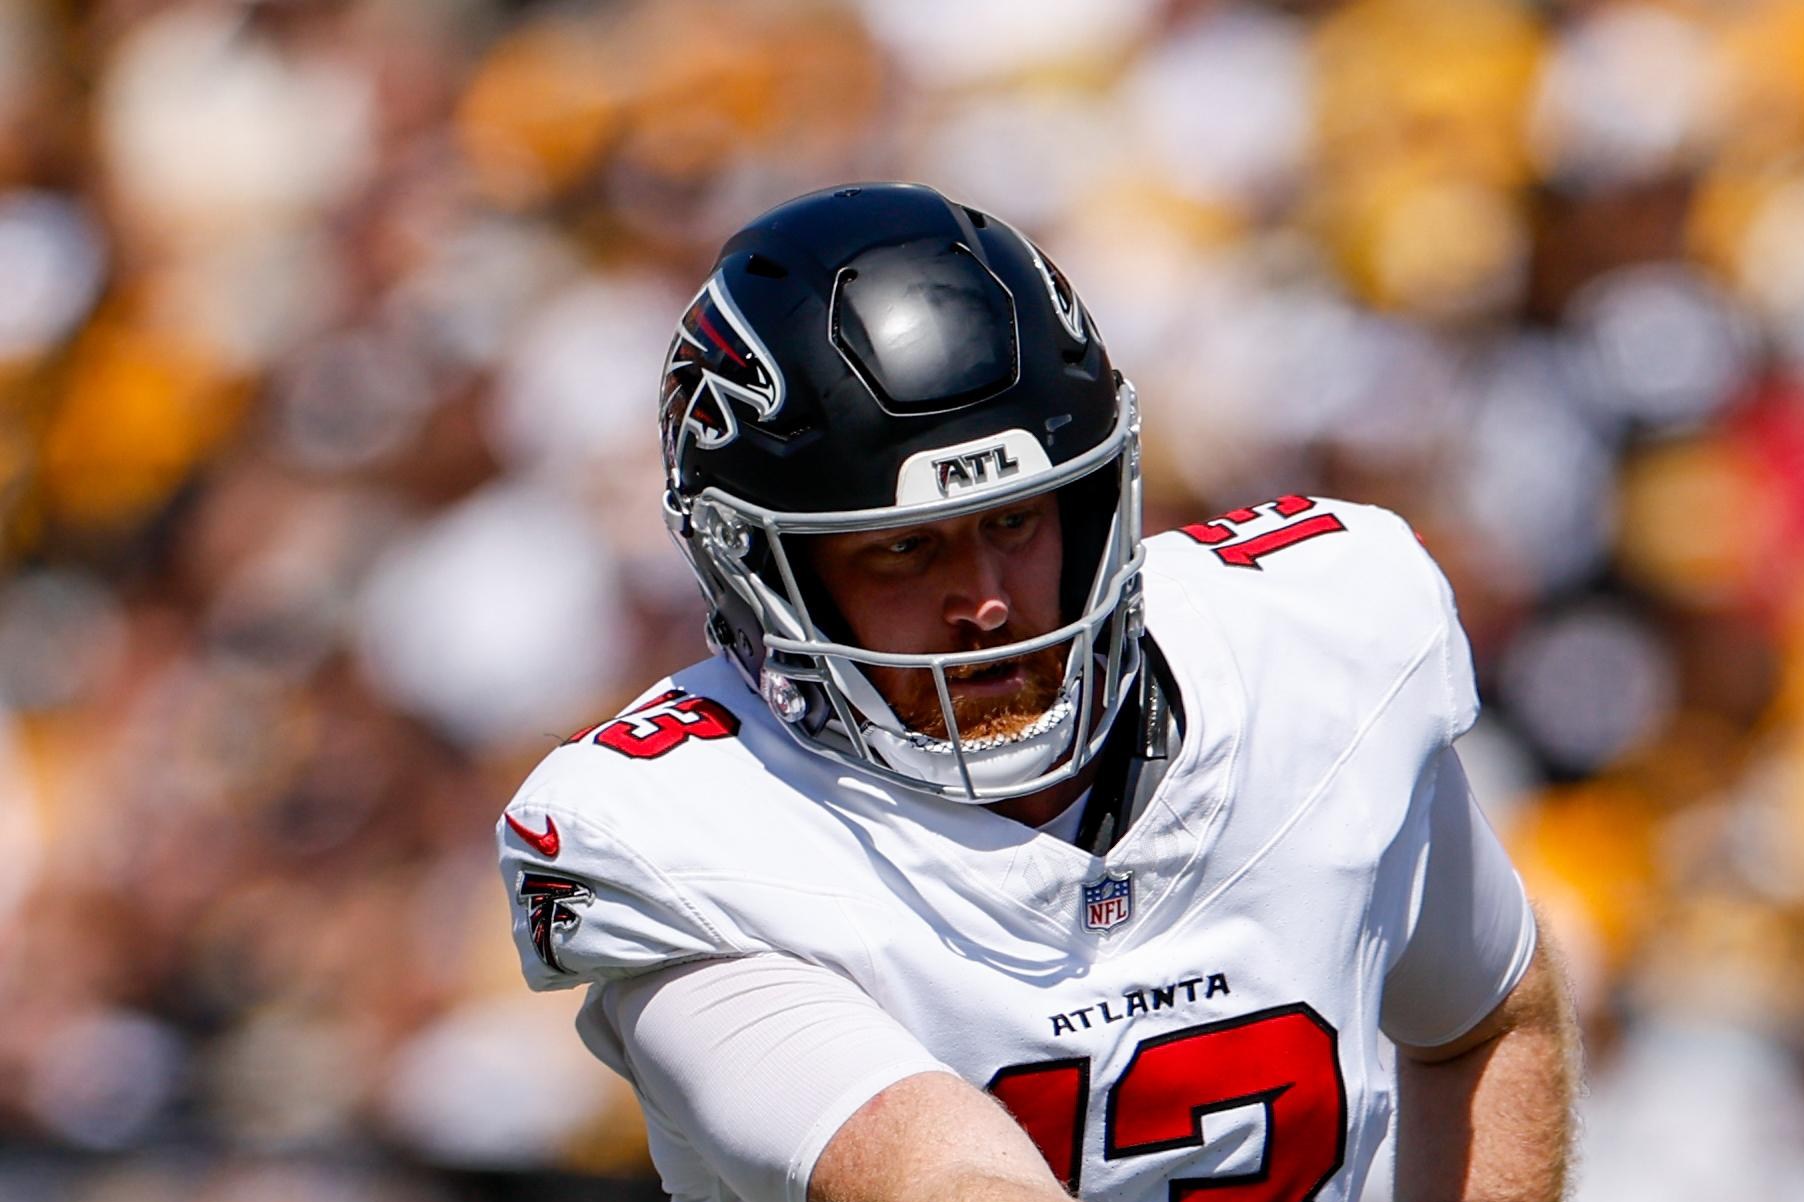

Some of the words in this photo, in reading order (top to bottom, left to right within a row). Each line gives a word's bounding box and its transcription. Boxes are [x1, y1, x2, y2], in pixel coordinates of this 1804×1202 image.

[931, 444, 1020, 497] ATL
[1089, 898, 1127, 925] NFL
[1049, 973, 1230, 1036] ATLANTA
